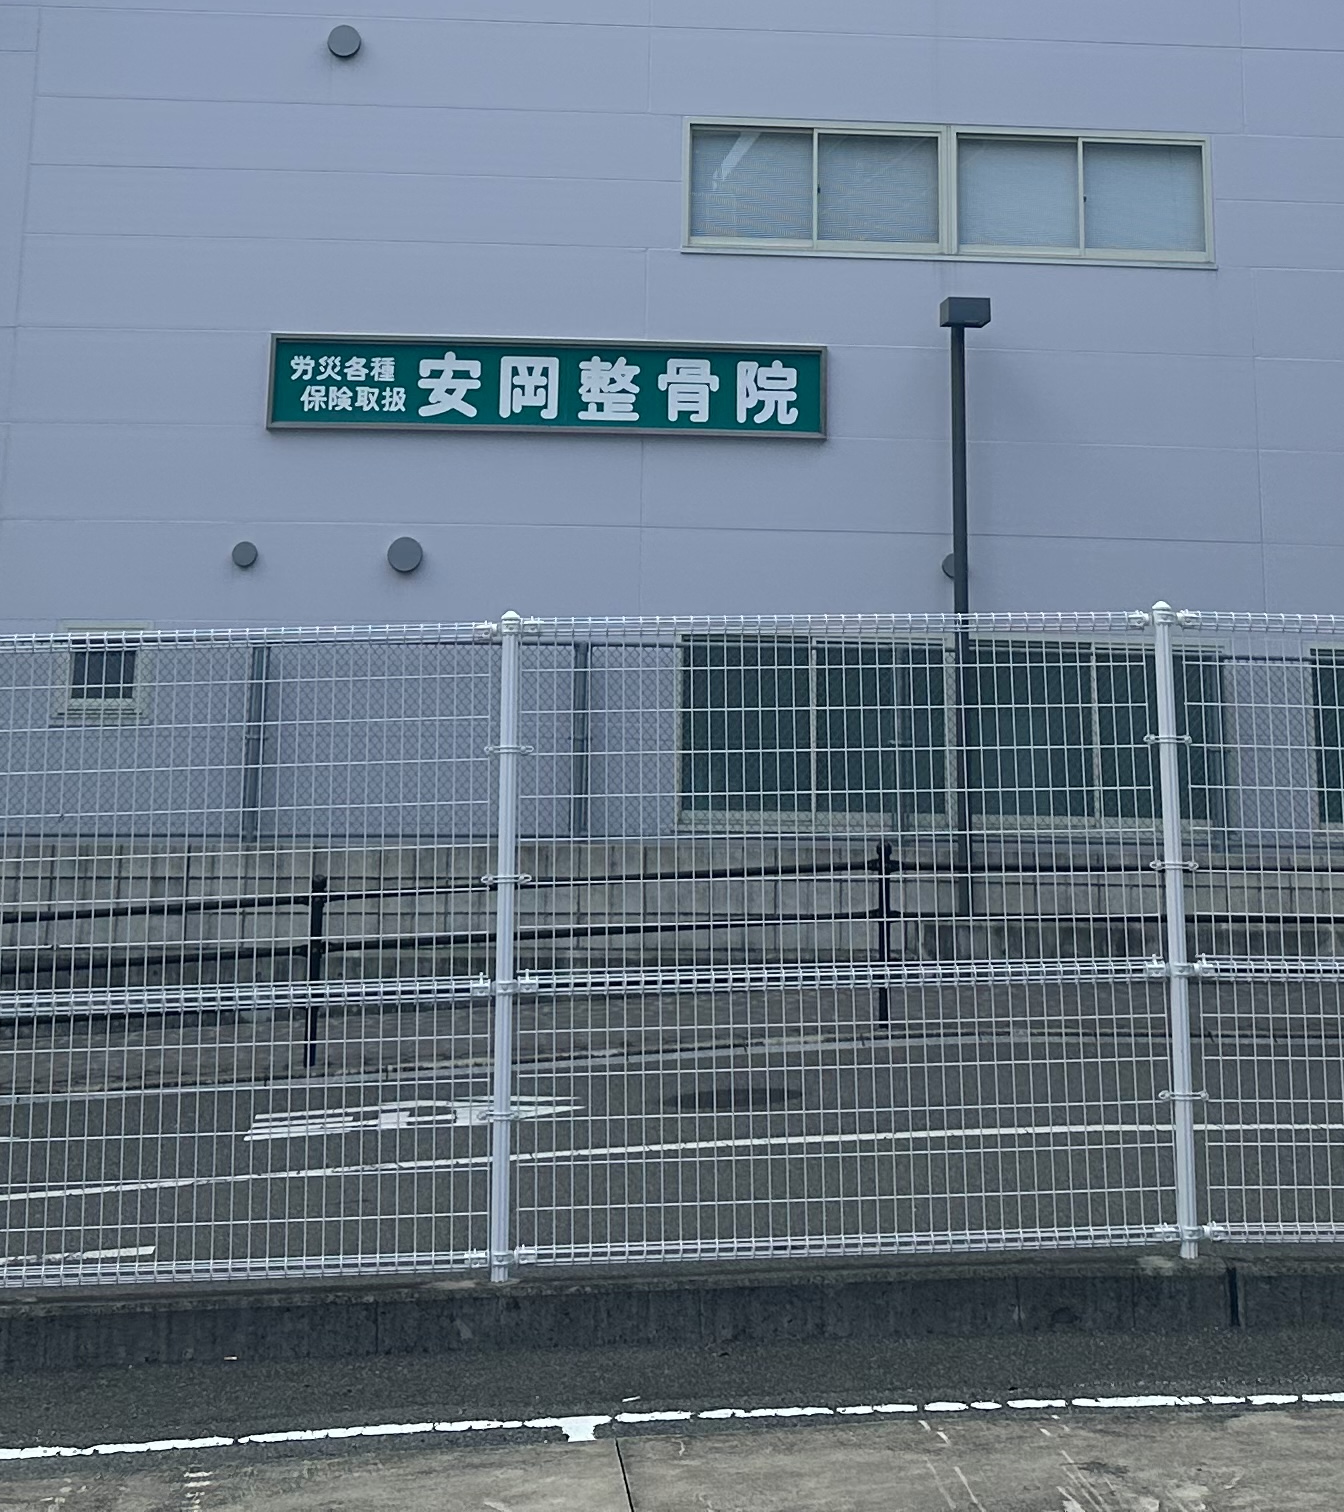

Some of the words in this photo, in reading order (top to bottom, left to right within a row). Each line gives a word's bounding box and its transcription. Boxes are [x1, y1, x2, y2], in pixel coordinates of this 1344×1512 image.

[289, 355, 396, 383] 労災各種
[301, 385, 407, 413] 保険取扱
[418, 351, 798, 425] 安岡整骨院
